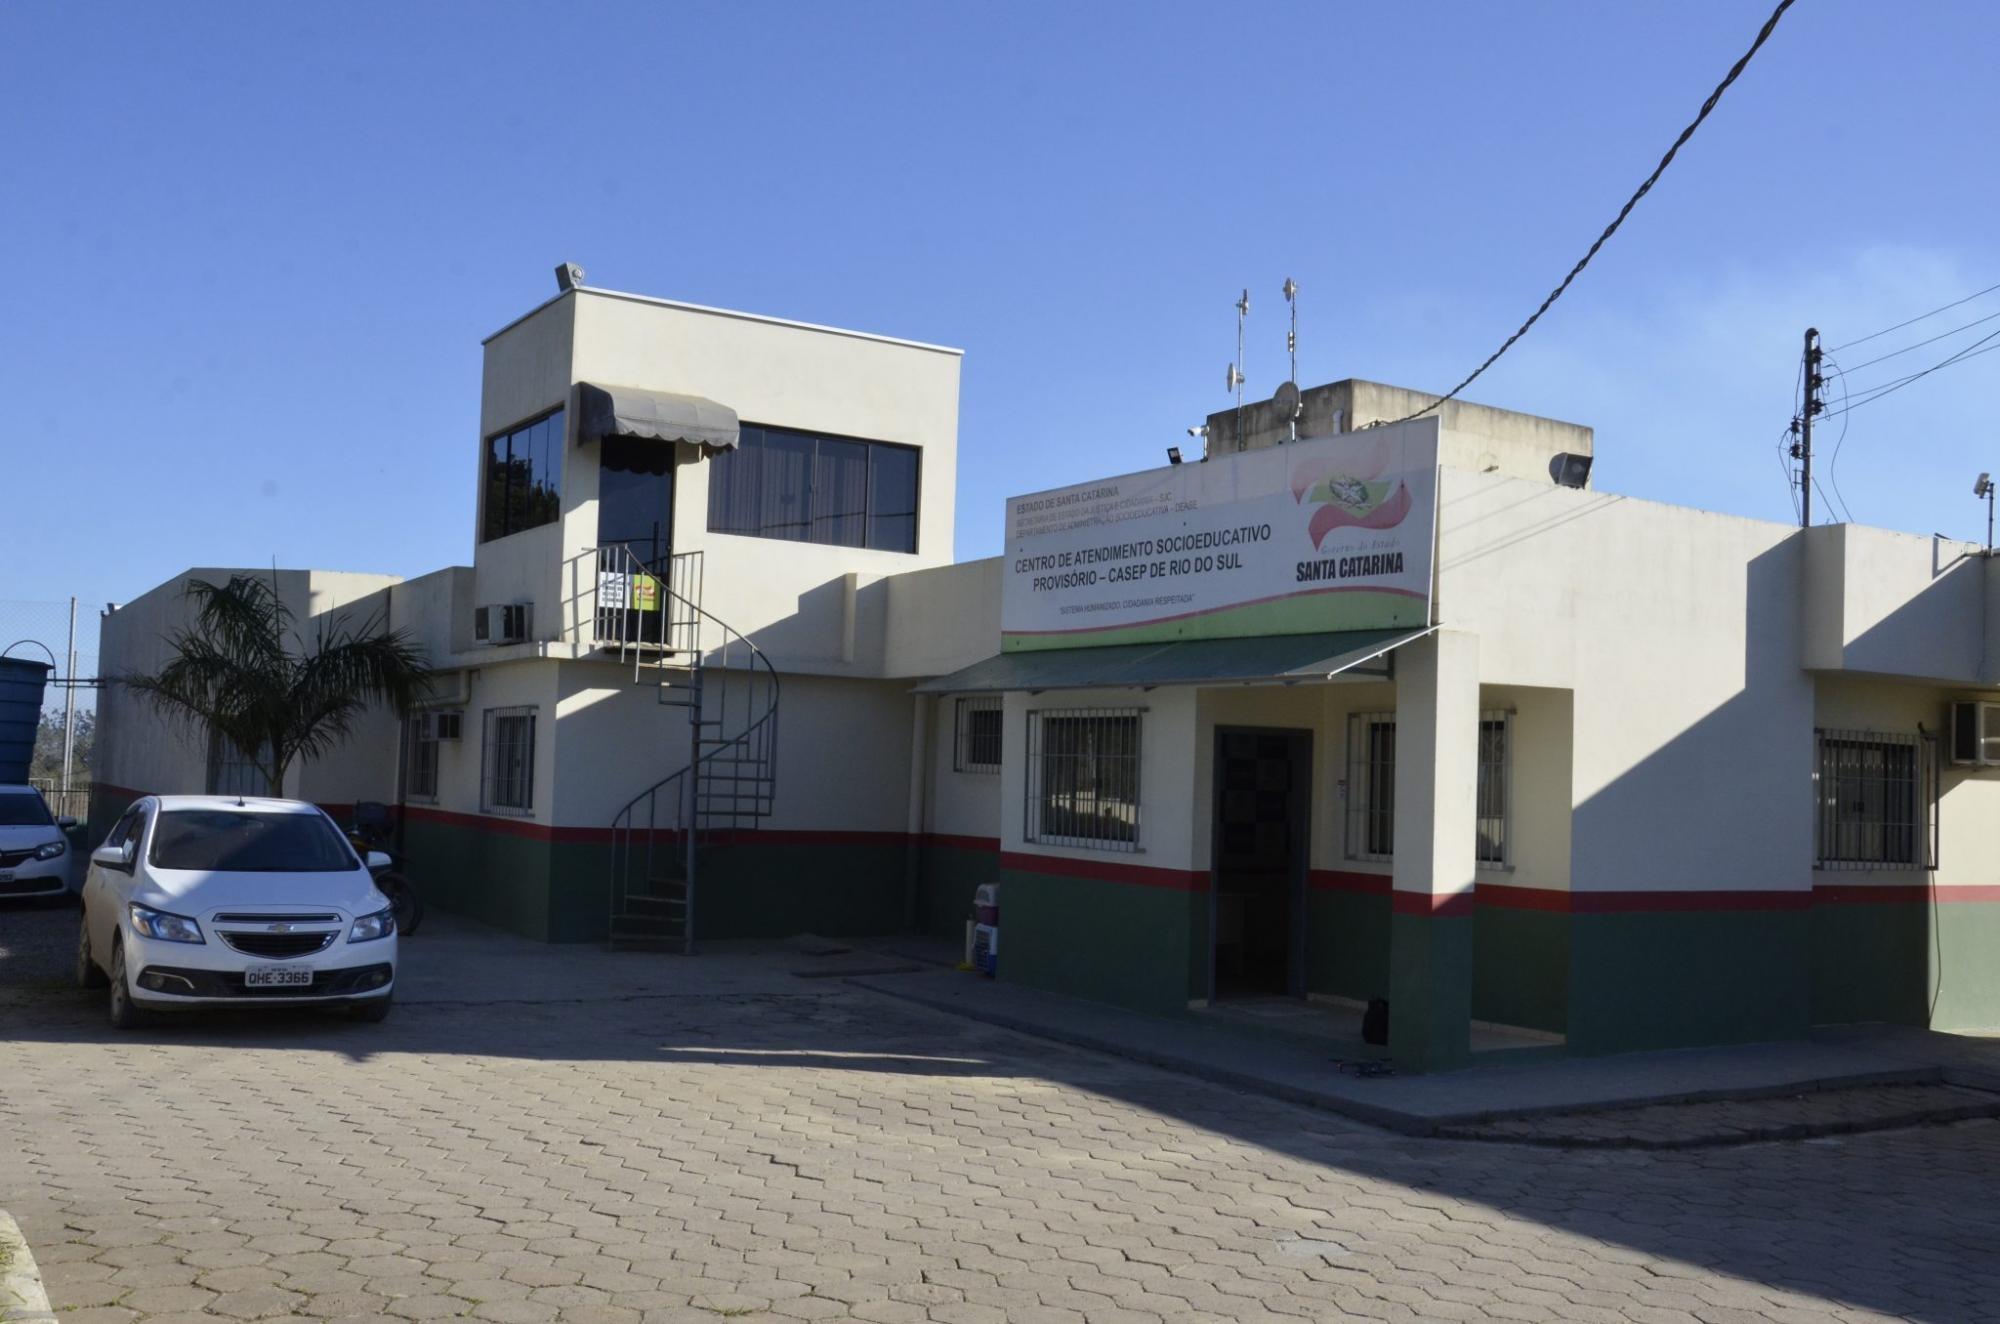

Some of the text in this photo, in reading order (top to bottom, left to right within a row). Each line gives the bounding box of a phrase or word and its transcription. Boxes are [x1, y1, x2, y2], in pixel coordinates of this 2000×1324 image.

[1017, 486, 1119, 514] ESTADO DE SANTA CATARINA
[1016, 524, 1271, 574] CENTRO DE ATENDIMENTO SOCIOEDUCATIVO
[1033, 570, 1097, 592] PROVISÓRIO
[1108, 563, 1147, 582] CASEP
[1150, 561, 1166, 578] DE
[1169, 559, 1191, 576] RIO
[1194, 556, 1213, 573] DO
[1217, 552, 1243, 570] SUL
[1296, 552, 1404, 582] SANTA CATARINA
